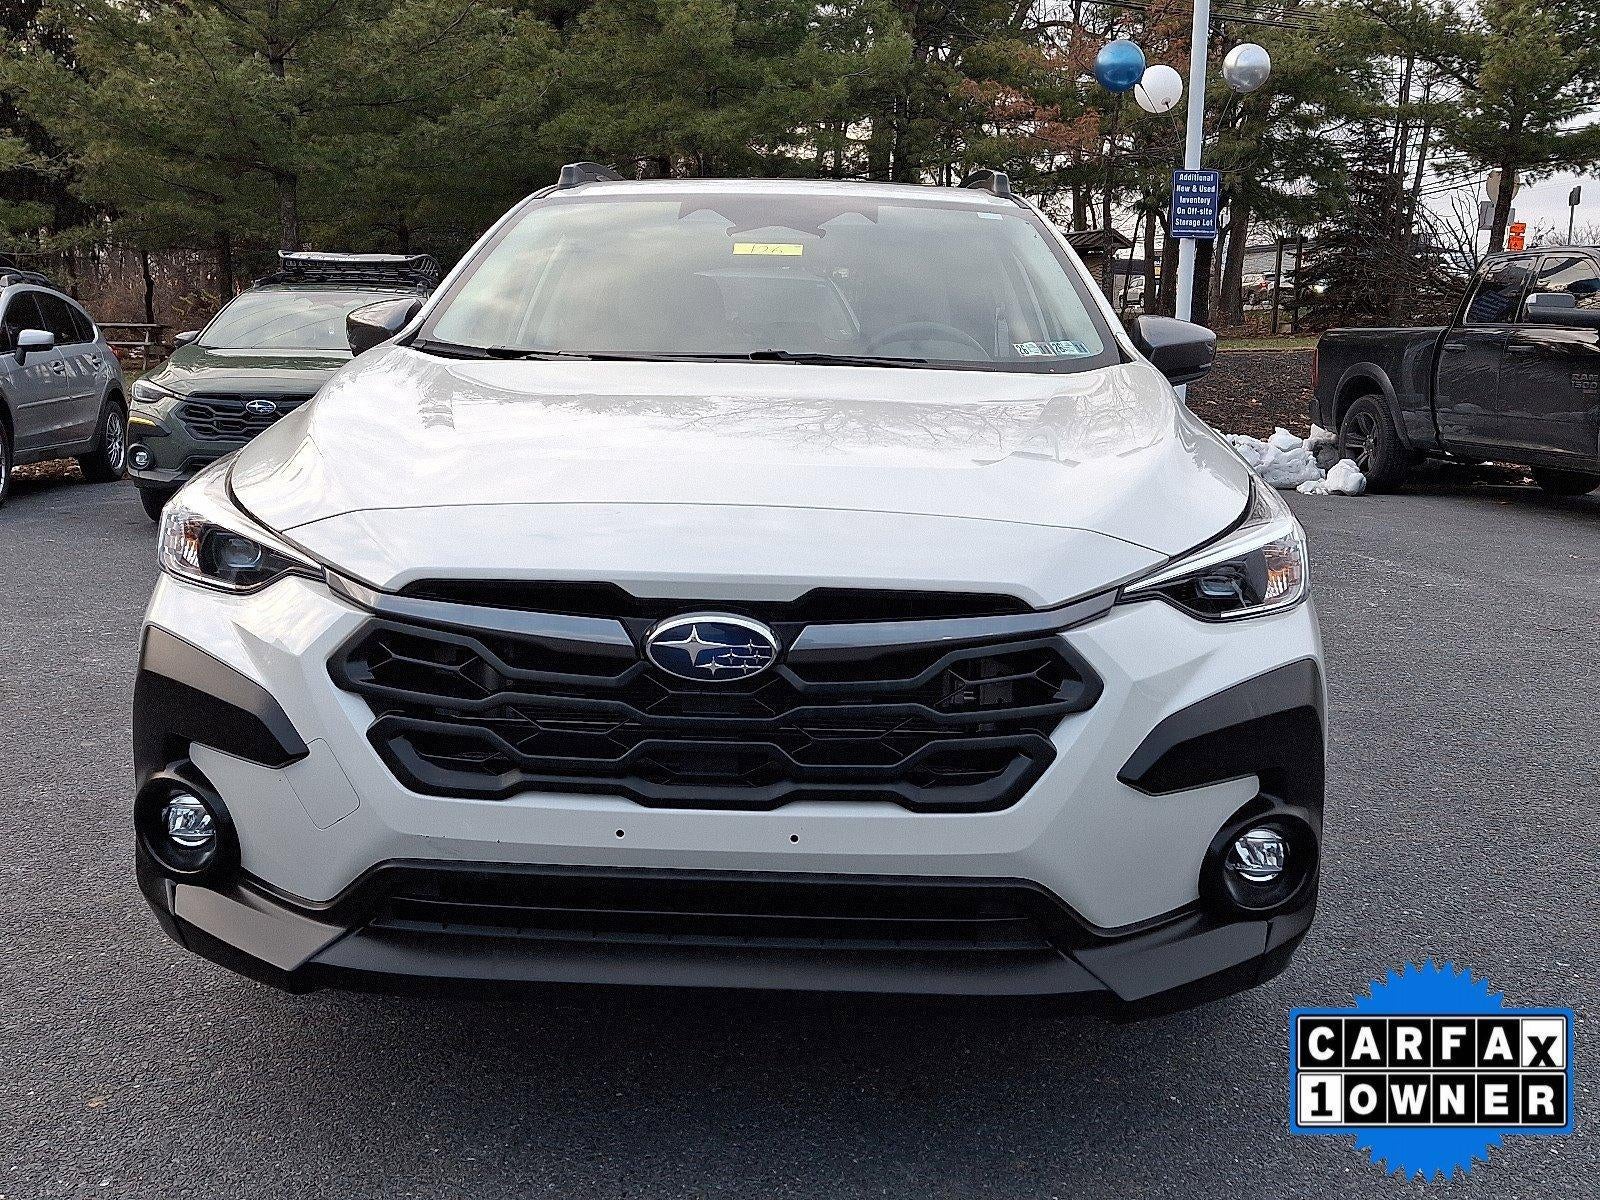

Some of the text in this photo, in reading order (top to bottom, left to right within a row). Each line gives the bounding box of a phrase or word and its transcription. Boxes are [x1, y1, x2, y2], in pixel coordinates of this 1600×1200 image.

[1179, 173, 1214, 181] Additional
[1176, 184, 1216, 193] New & Used
[1180, 196, 1211, 205] Inventory
[1176, 207, 1213, 215] On Off-site
[1175, 218, 1201, 227] Storage
[1571, 380, 1598, 389] 1500
